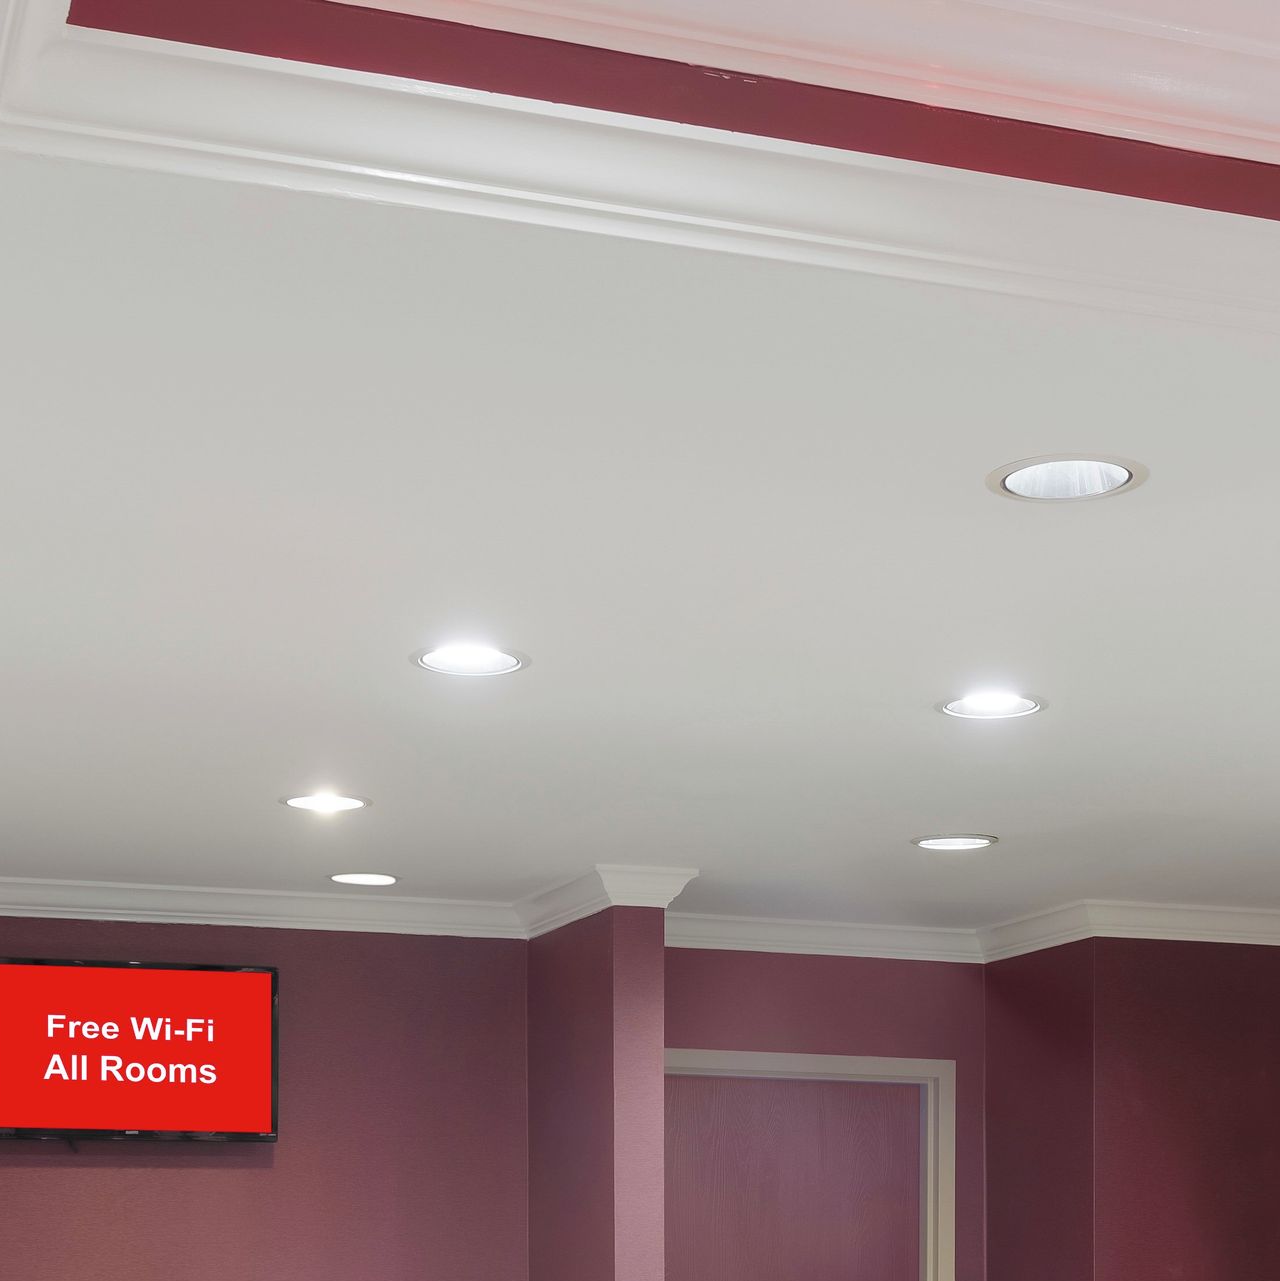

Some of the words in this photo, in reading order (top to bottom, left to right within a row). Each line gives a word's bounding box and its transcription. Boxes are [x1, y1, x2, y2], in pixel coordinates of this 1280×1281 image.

[47, 1013, 119, 1039] Free
[130, 1016, 214, 1042] Wi-Fi
[44, 1054, 87, 1080] All
[100, 1056, 217, 1084] Rooms
